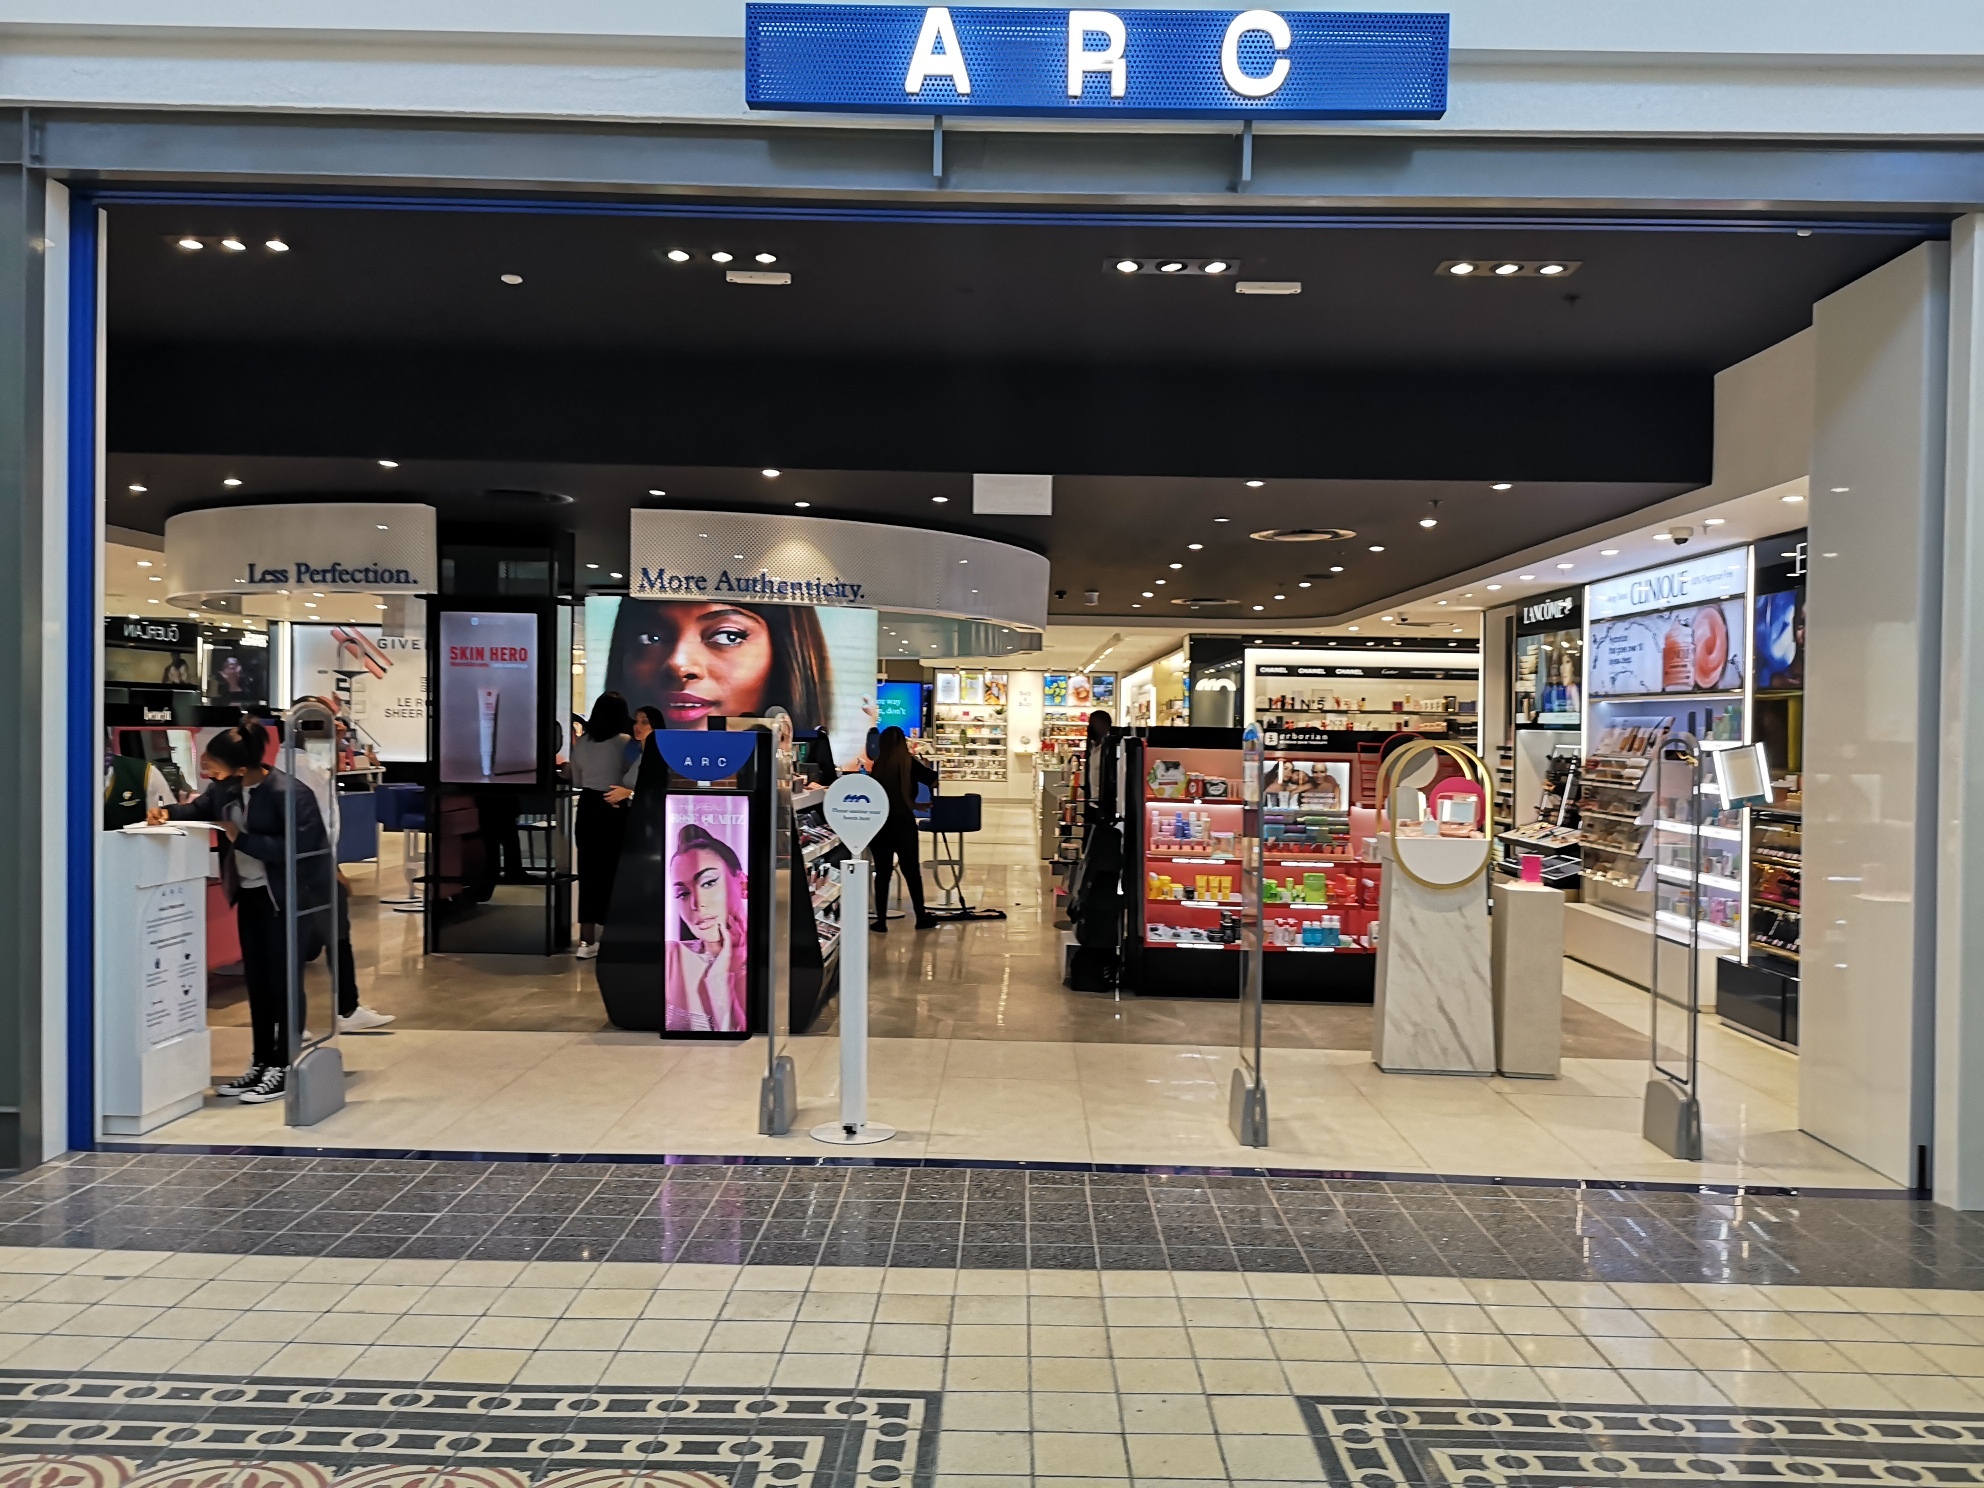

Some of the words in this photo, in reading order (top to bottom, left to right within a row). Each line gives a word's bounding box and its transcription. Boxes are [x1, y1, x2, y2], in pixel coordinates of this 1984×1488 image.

[904, 7, 1292, 98] ARC
[248, 563, 288, 584] Less
[295, 562, 418, 585] Perfection.
[638, 567, 707, 592] More
[714, 570, 865, 602] Authenticity.
[1630, 570, 1689, 605] CLINIQUE
[450, 646, 485, 661] SKIN
[490, 646, 528, 662] HERO
[1259, 666, 1288, 674] CHANEL
[1297, 667, 1326, 675] CHANEL
[1335, 668, 1364, 676] CHANEL
[397, 698, 411, 707] LE
[385, 708, 424, 718] SHEER
[1279, 732, 1329, 741] erborian
[701, 813, 745, 826] QUARTZ
